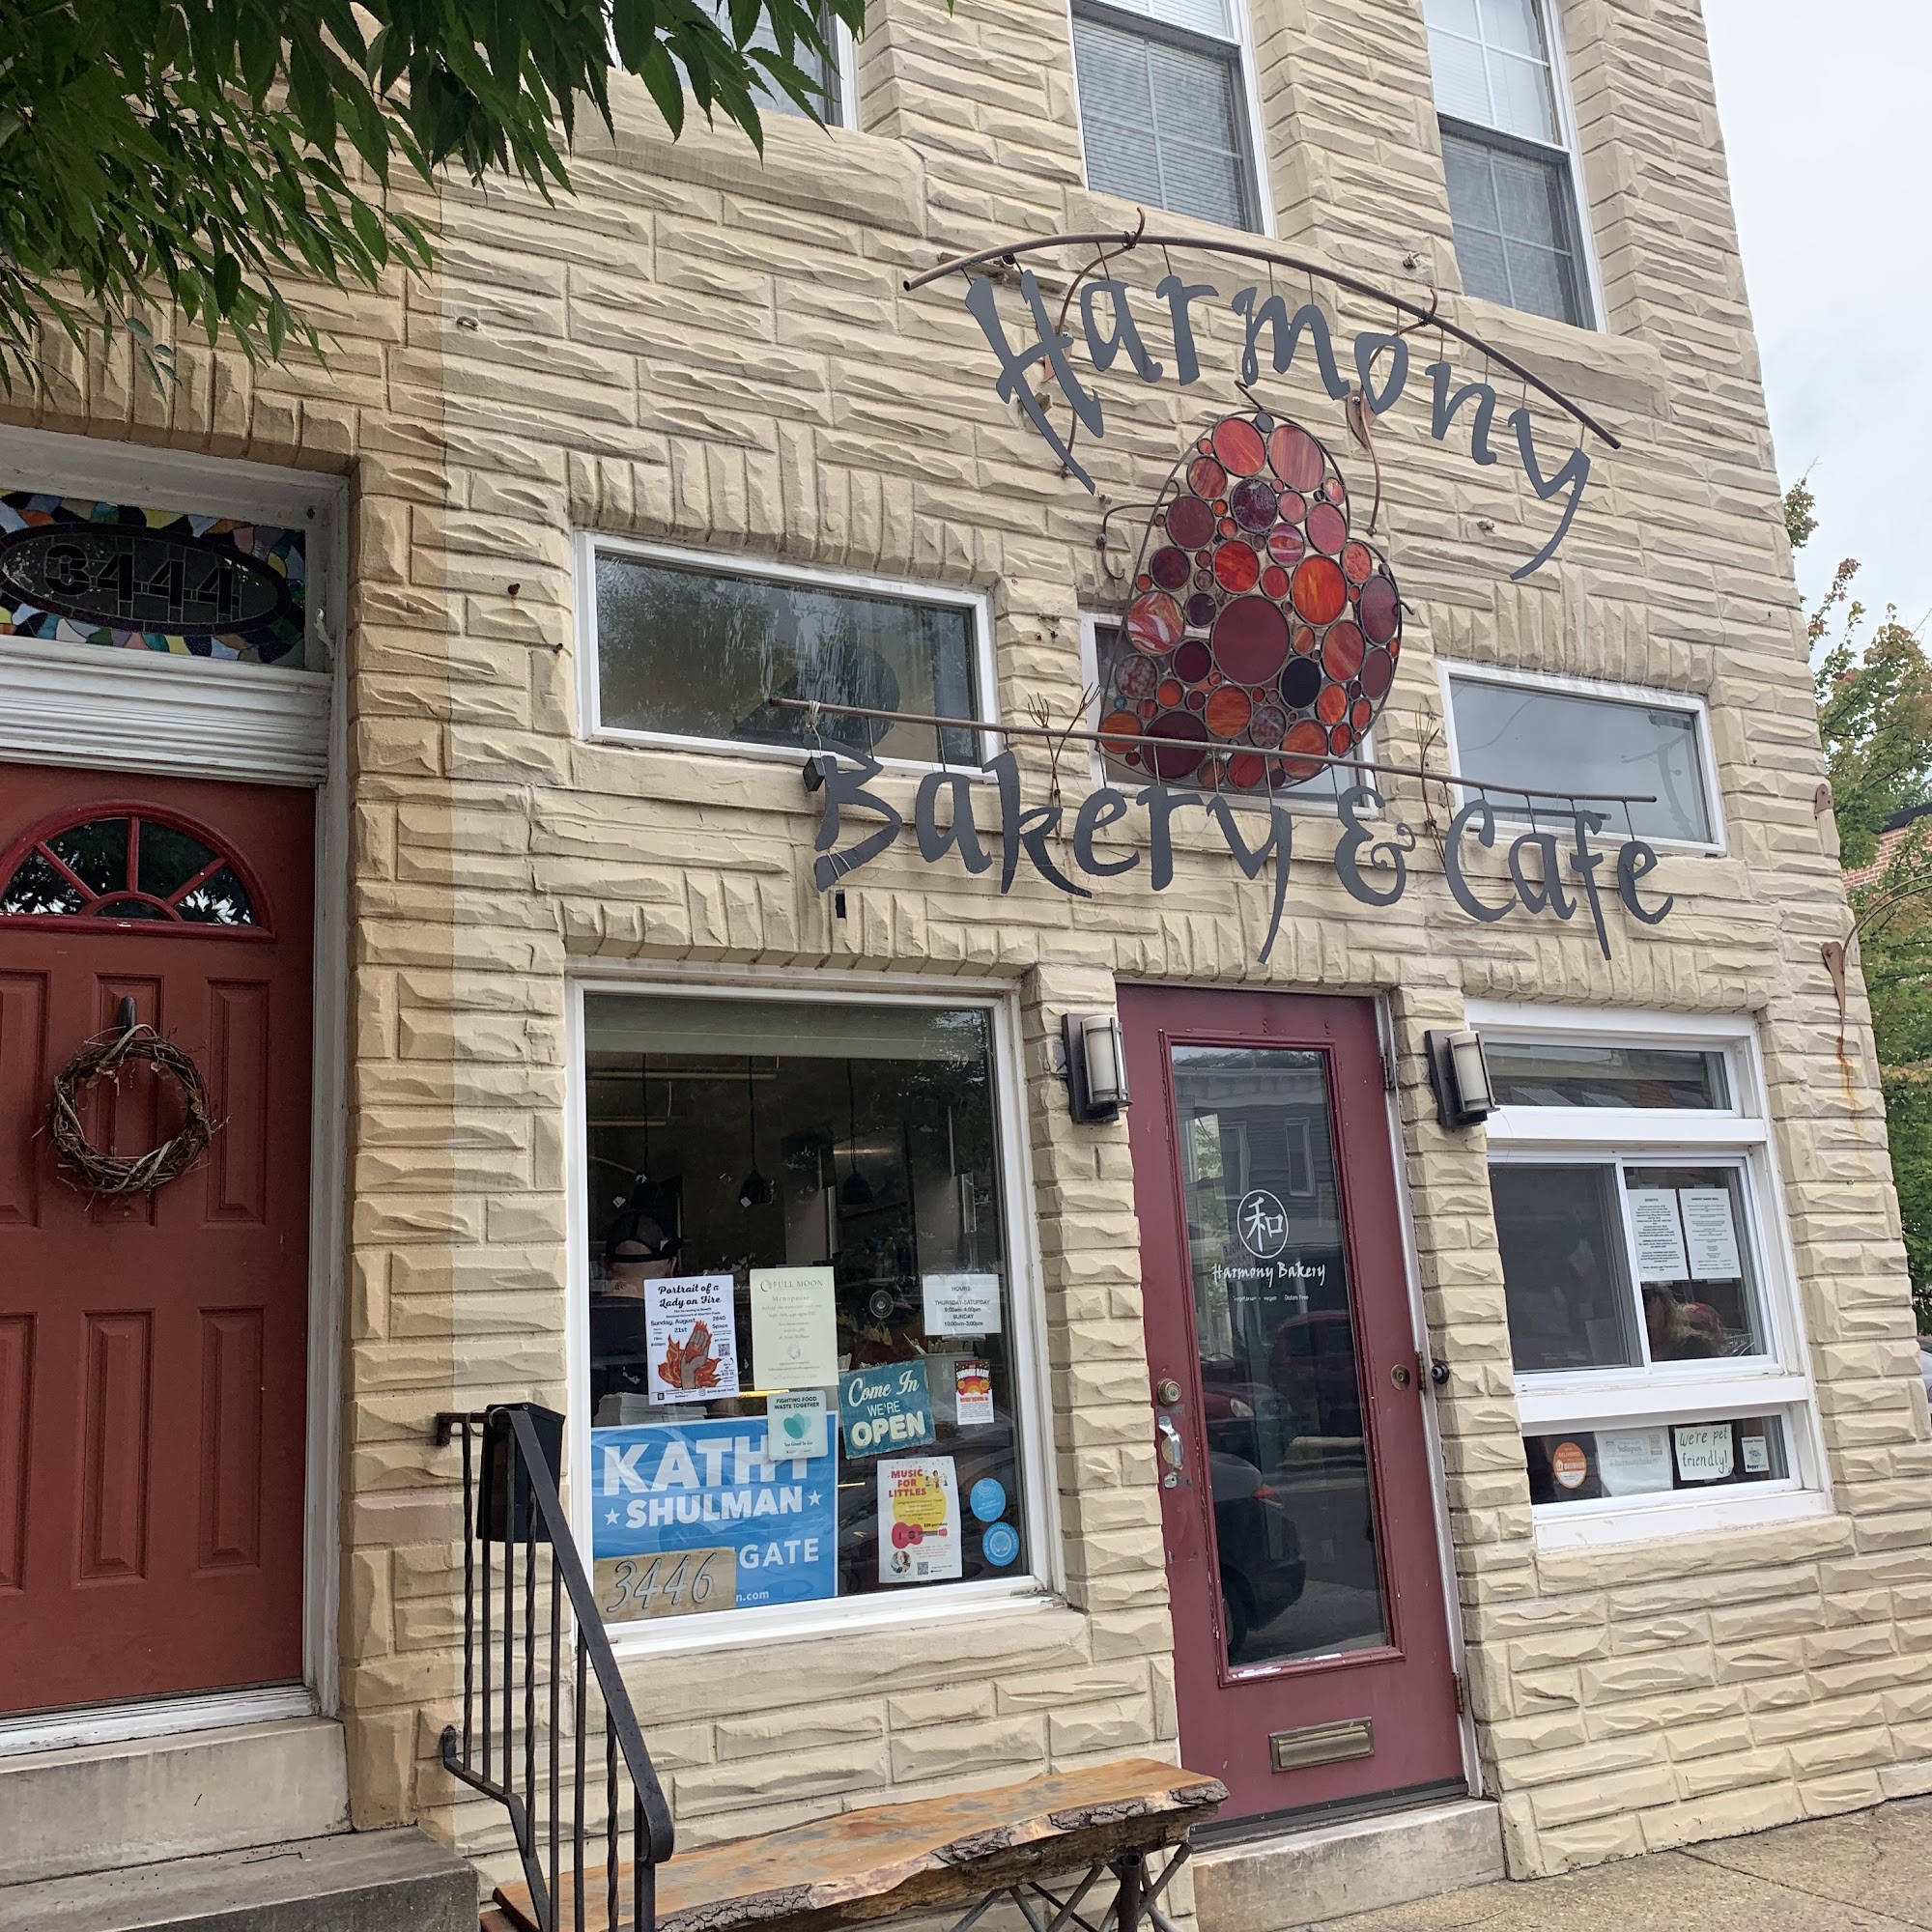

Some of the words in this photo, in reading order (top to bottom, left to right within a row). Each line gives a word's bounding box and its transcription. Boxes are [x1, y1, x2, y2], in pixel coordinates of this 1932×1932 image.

[966, 270, 1591, 580] Harmony
[45, 544, 241, 615] 3444
[803, 734, 1291, 965] Bakery
[1334, 784, 1417, 906] &
[1445, 799, 1674, 961] Cafe
[1244, 1196, 1284, 1253] 和
[796, 1279, 823, 1288] MOON
[1211, 1263, 1273, 1289] Harmony
[1277, 1261, 1325, 1287] Bakery
[658, 1284, 699, 1294] Portrait
[700, 1283, 712, 1294] of
[659, 1297, 685, 1309] Lady
[700, 1295, 722, 1304] Fire
[848, 1378, 892, 1407] Come
[895, 1369, 920, 1395] In
[867, 1400, 901, 1417] WE'RE
[851, 1410, 926, 1448] OPEN
[1713, 1426, 1727, 1446] pet
[891, 1468, 923, 1479] MUSIC
[1682, 1449, 1728, 1474] friendly!
[889, 1488, 926, 1498] LITTLES
[897, 1478, 917, 1488] FOR
[625, 1485, 803, 1529] SHULMAN
[607, 1551, 718, 1613] 3446
